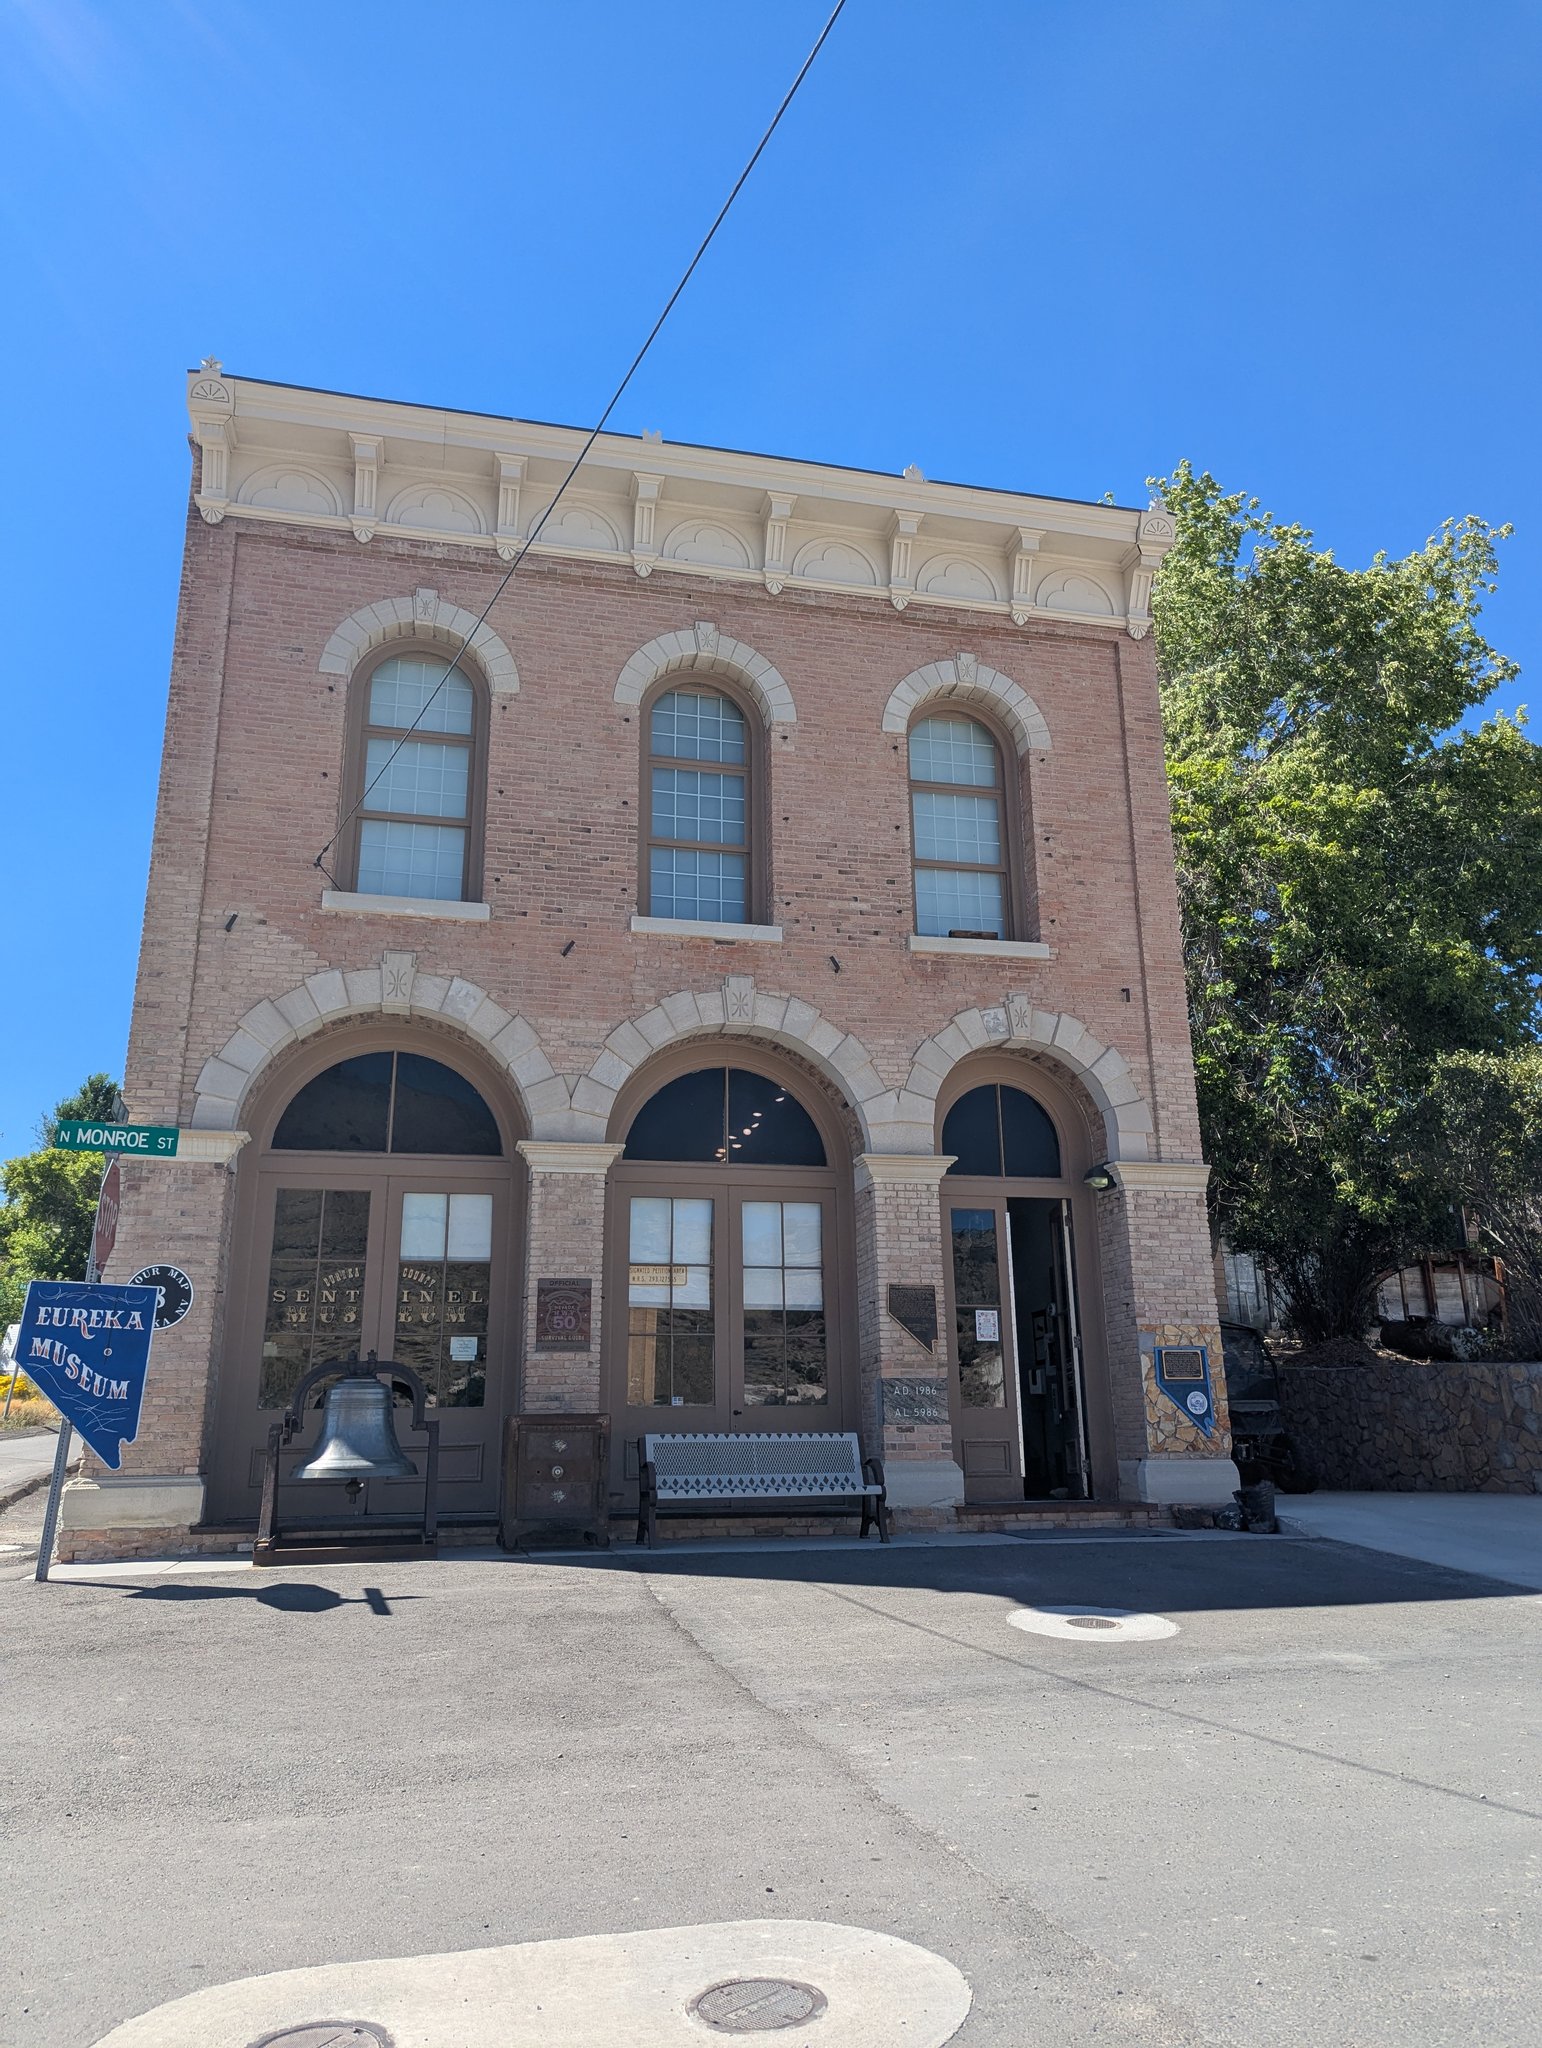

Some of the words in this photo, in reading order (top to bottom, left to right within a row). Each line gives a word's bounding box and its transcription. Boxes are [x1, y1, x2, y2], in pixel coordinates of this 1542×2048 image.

[60, 1130, 70, 1142] N
[76, 1128, 150, 1148] MONROE
[157, 1137, 174, 1150] ST
[97, 1193, 118, 1240] STOP
[131, 1267, 160, 1285] OUR
[168, 1268, 190, 1290] MAP
[402, 1267, 436, 1288] COUNTY
[36, 1306, 144, 1340] EUREKA
[553, 1315, 576, 1329] 50
[29, 1337, 130, 1400] MUSEUM
[915, 1385, 937, 1395] 1986
[914, 1407, 938, 1417] 5986
